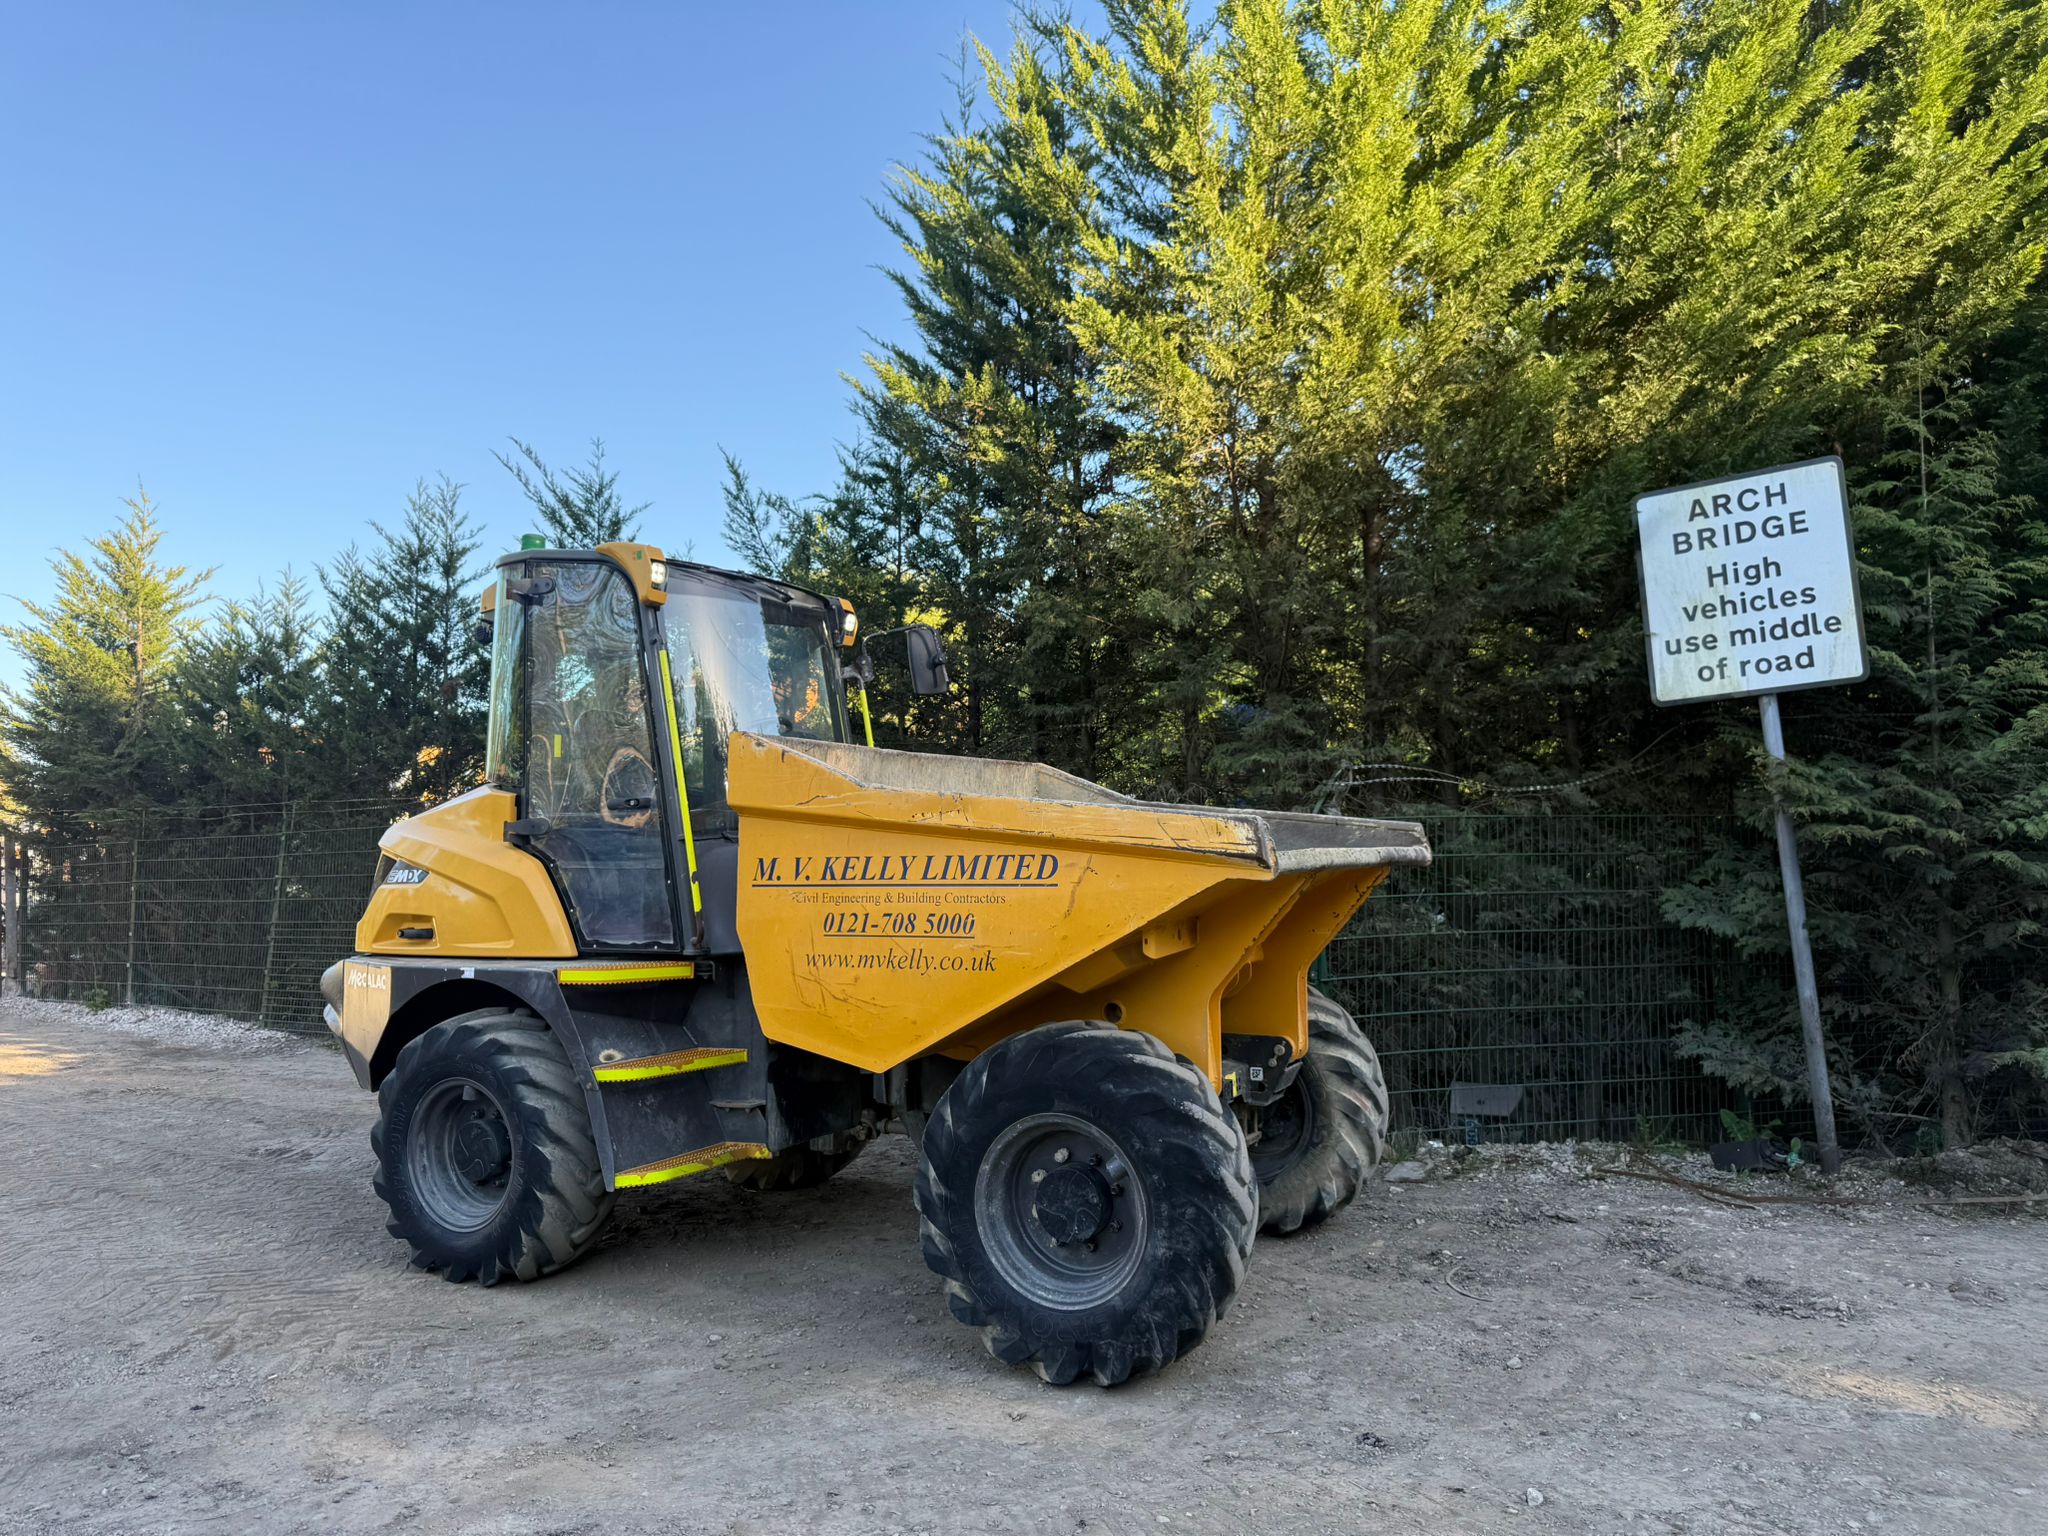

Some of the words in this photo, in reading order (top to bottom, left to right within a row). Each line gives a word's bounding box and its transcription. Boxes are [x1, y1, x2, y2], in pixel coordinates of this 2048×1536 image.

[1688, 482, 1787, 522] ARCH
[1672, 510, 1809, 555] BRIDGE
[1706, 556, 1782, 588] High
[1682, 586, 1817, 622] vehicles
[1664, 633, 1718, 655] use
[1729, 612, 1842, 647] middle
[1698, 657, 1728, 682] of
[1739, 645, 1815, 677] road
[752, 856, 782, 882] M.
[794, 856, 814, 881] V.
[820, 855, 918, 881] KELLY
[922, 854, 1059, 881] LIMITED
[822, 892, 881, 906] Engineering
[884, 892, 894, 903] &
[897, 892, 941, 906] Building
[944, 892, 1007, 904] Contractors
[823, 912, 917, 935] 0121-708
[925, 912, 976, 935] 5000
[805, 948, 998, 975] www.mvkelly.co.uk
